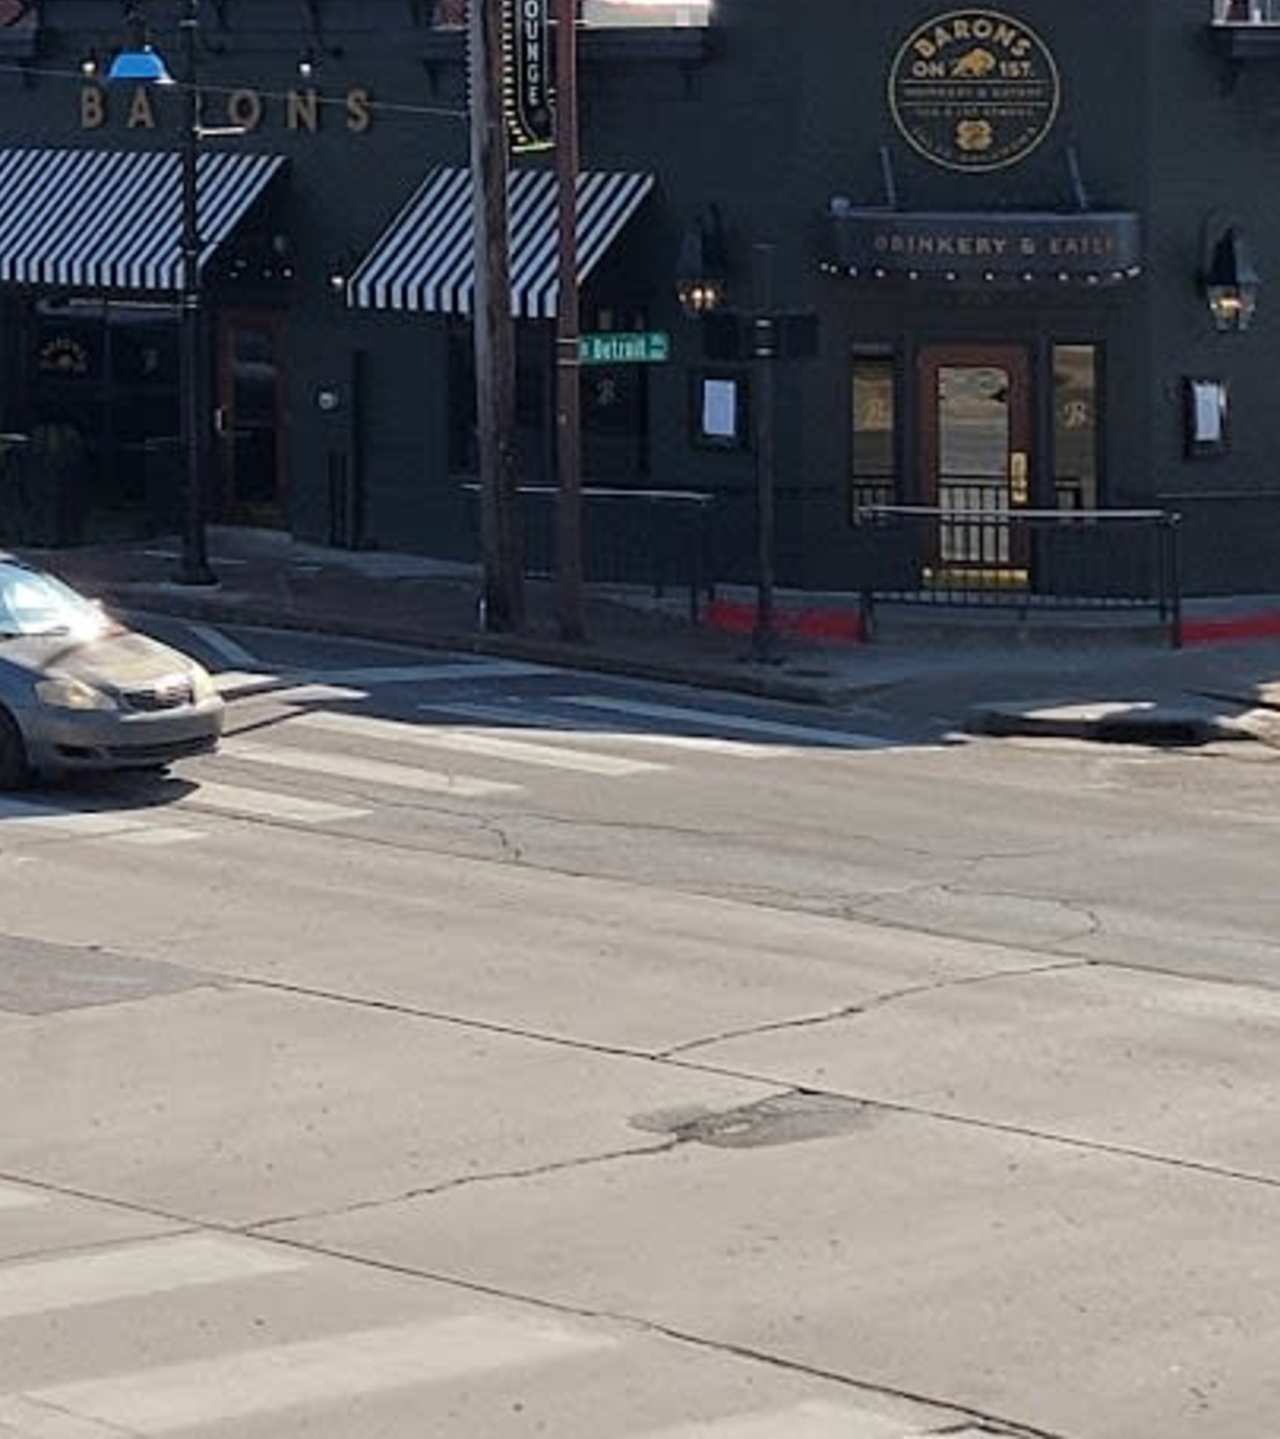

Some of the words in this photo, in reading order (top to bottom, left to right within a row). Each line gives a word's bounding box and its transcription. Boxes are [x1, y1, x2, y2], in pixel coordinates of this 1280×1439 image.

[913, 18, 1033, 59] BARONS
[911, 61, 946, 78] ON
[79, 85, 373, 133] BAONS
[592, 336, 646, 360] Detroit
